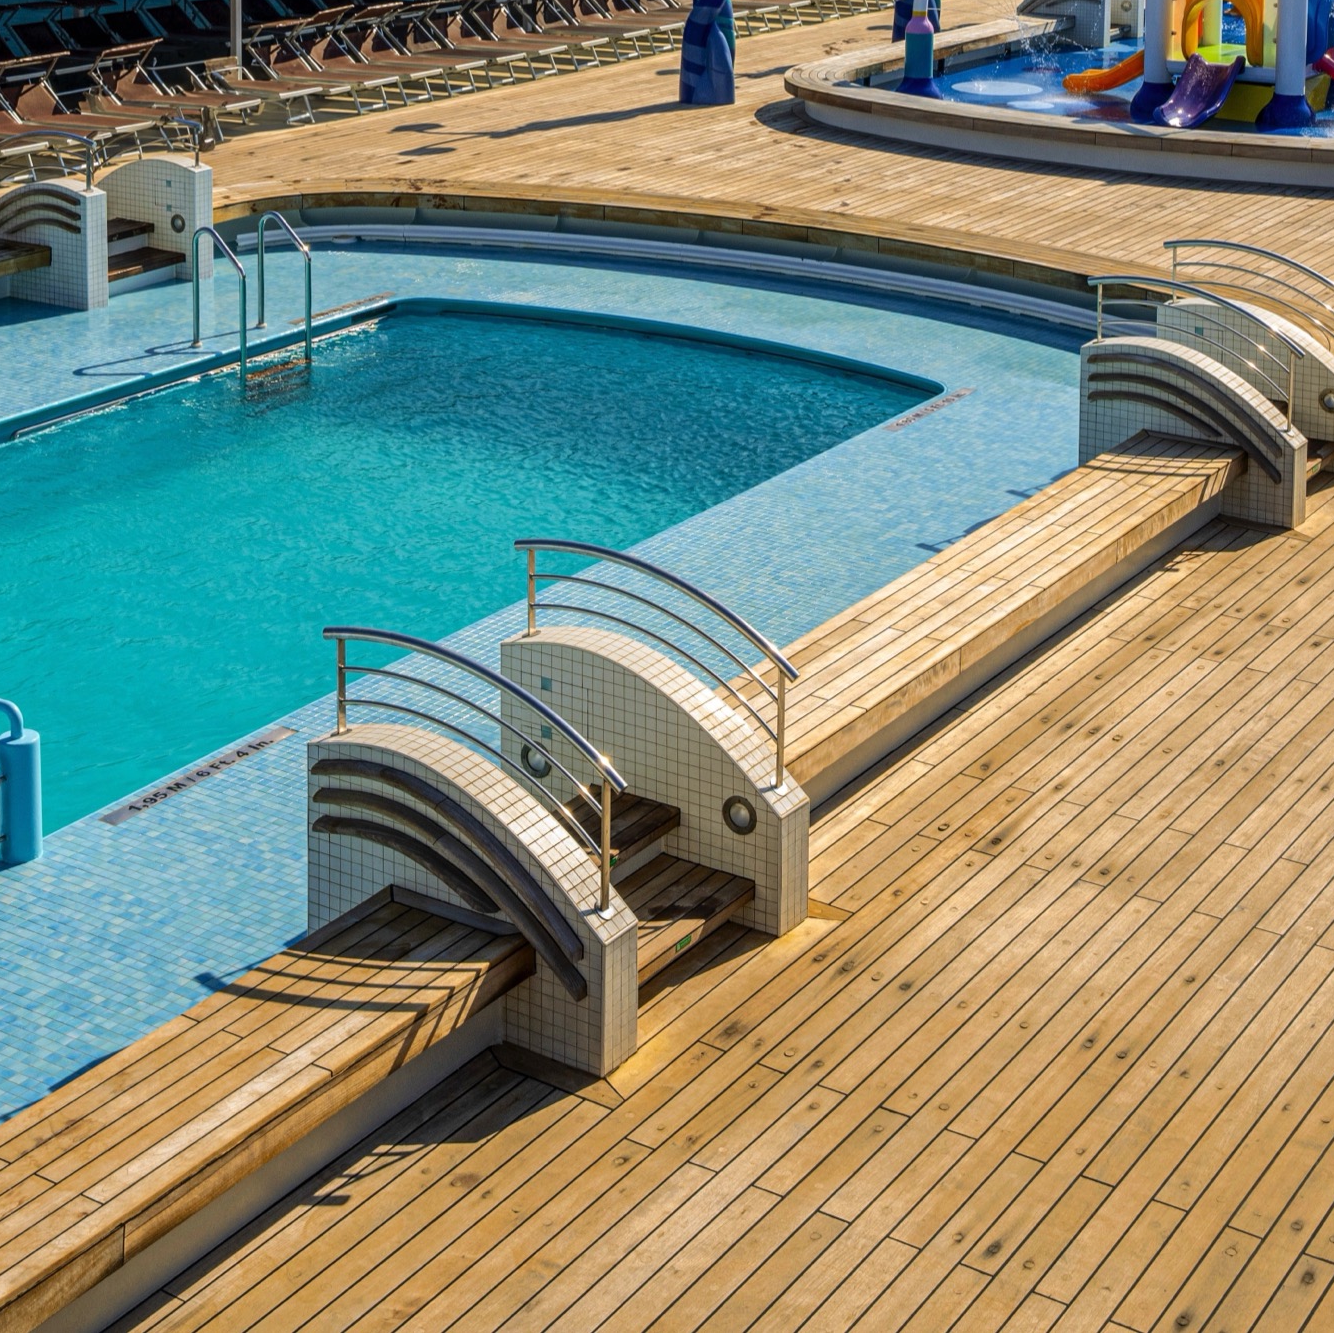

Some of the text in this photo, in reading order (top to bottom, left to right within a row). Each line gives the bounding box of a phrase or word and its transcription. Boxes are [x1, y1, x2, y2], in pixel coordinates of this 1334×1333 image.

[128, 791, 168, 813] 1,95
[167, 781, 187, 793] M
[196, 769, 211, 777] 6
[209, 759, 236, 771] Ft.
[235, 749, 249, 759] 4
[248, 738, 274, 751] In.
